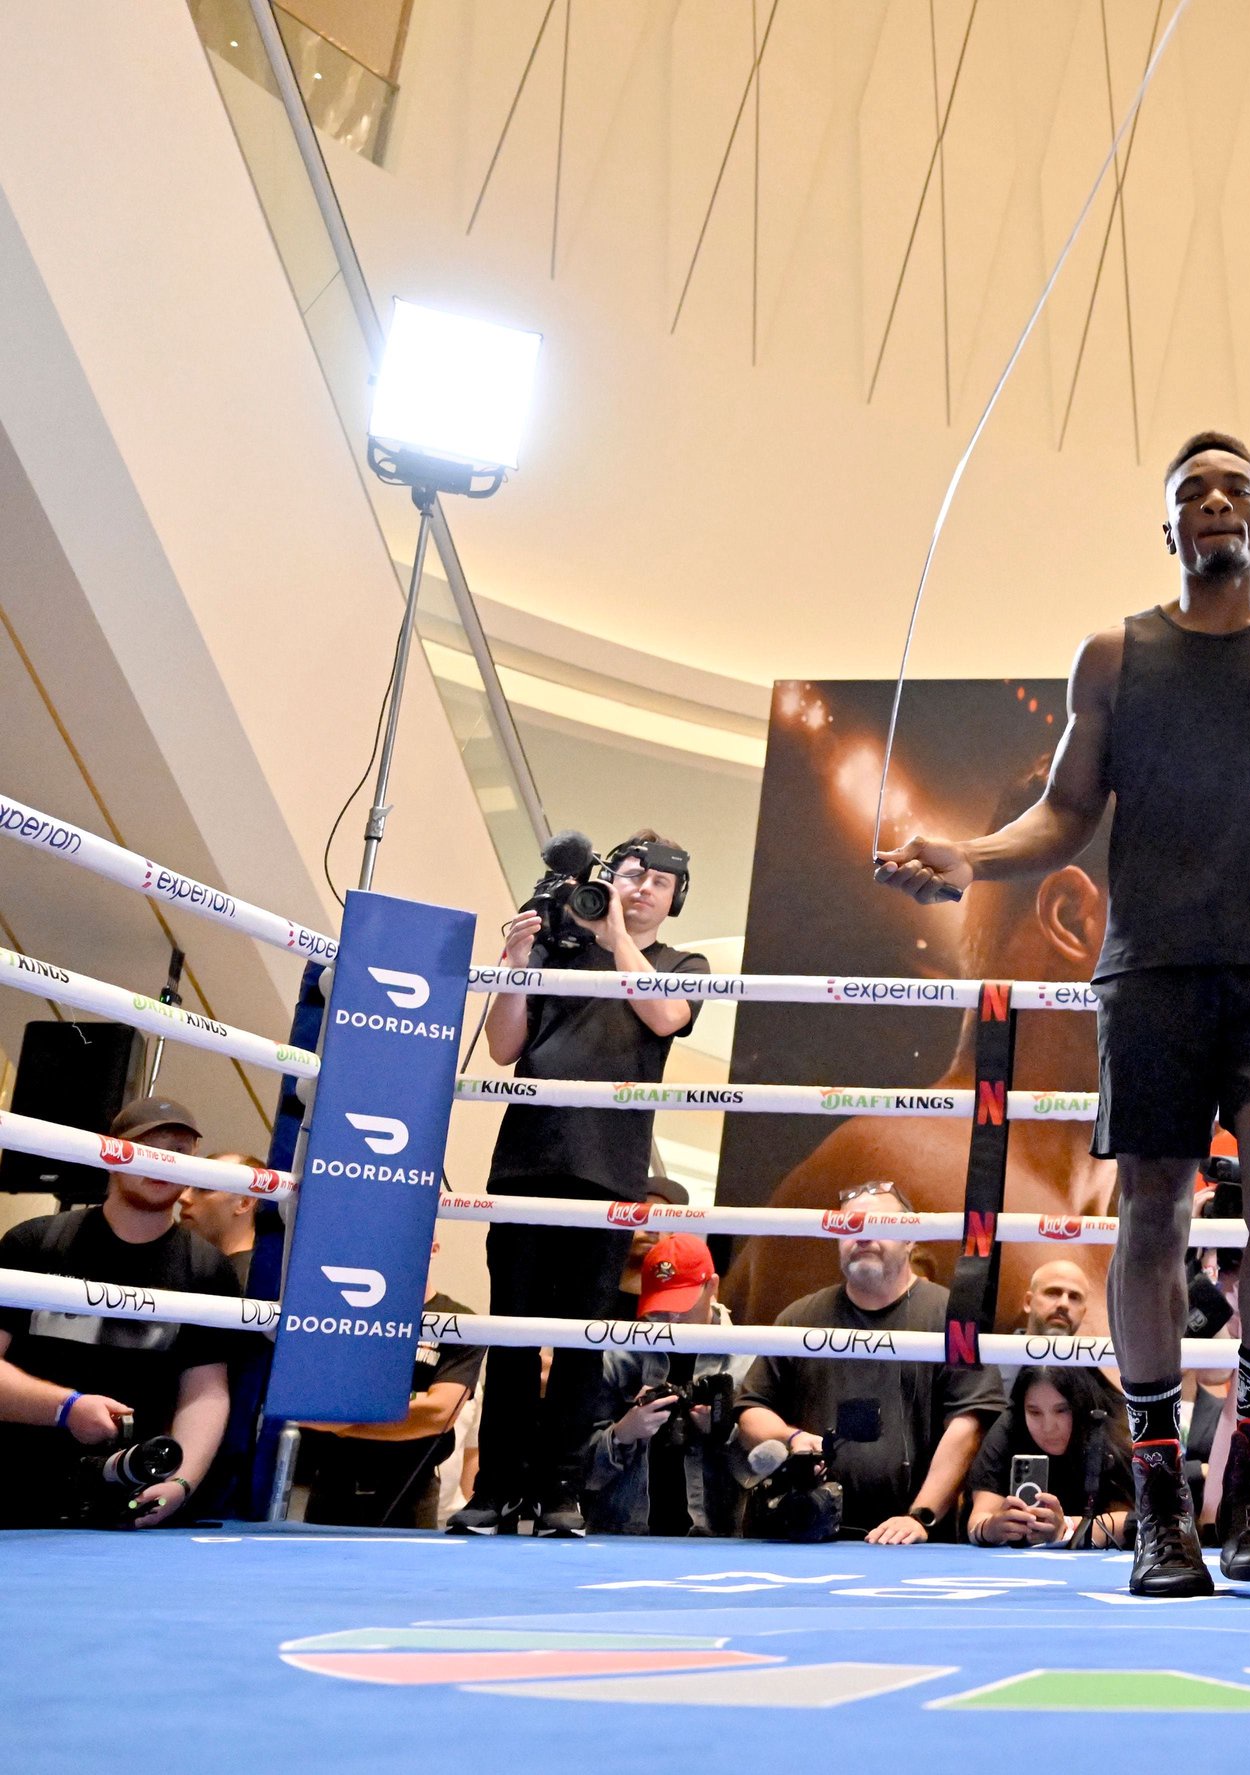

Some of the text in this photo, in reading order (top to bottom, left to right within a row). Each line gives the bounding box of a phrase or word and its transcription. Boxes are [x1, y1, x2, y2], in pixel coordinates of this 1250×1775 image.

[156, 870, 236, 917] experian
[298, 929, 340, 961] expe
[467, 966, 543, 987] perian
[636, 975, 747, 997] experian
[842, 982, 956, 1002] experian
[981, 983, 1009, 1023] N
[132, 993, 228, 1037] DRAFTKINGS
[335, 1009, 456, 1041] DOORDASH
[457, 1080, 537, 1097] FTKINGS
[613, 1085, 745, 1104] DRAFTKINGS
[820, 1092, 955, 1111] DRAFTKINGS
[977, 1081, 1005, 1125] N
[99, 1135, 131, 1162] Jack
[250, 1169, 276, 1192] Jack
[311, 1157, 435, 1187] DOORDASH
[441, 1197, 494, 1210] in the box
[608, 1202, 646, 1225] Jack
[821, 1210, 864, 1233] Jack
[900, 1213, 921, 1225] box
[964, 1211, 994, 1257] N
[1038, 1215, 1081, 1239] Jack
[83, 1278, 156, 1313] OURA
[285, 1315, 413, 1339] DOORDASH
[420, 1314, 462, 1339] RA
[584, 1321, 675, 1346] OURA
[802, 1329, 896, 1355] OURA
[948, 1320, 976, 1365] N
